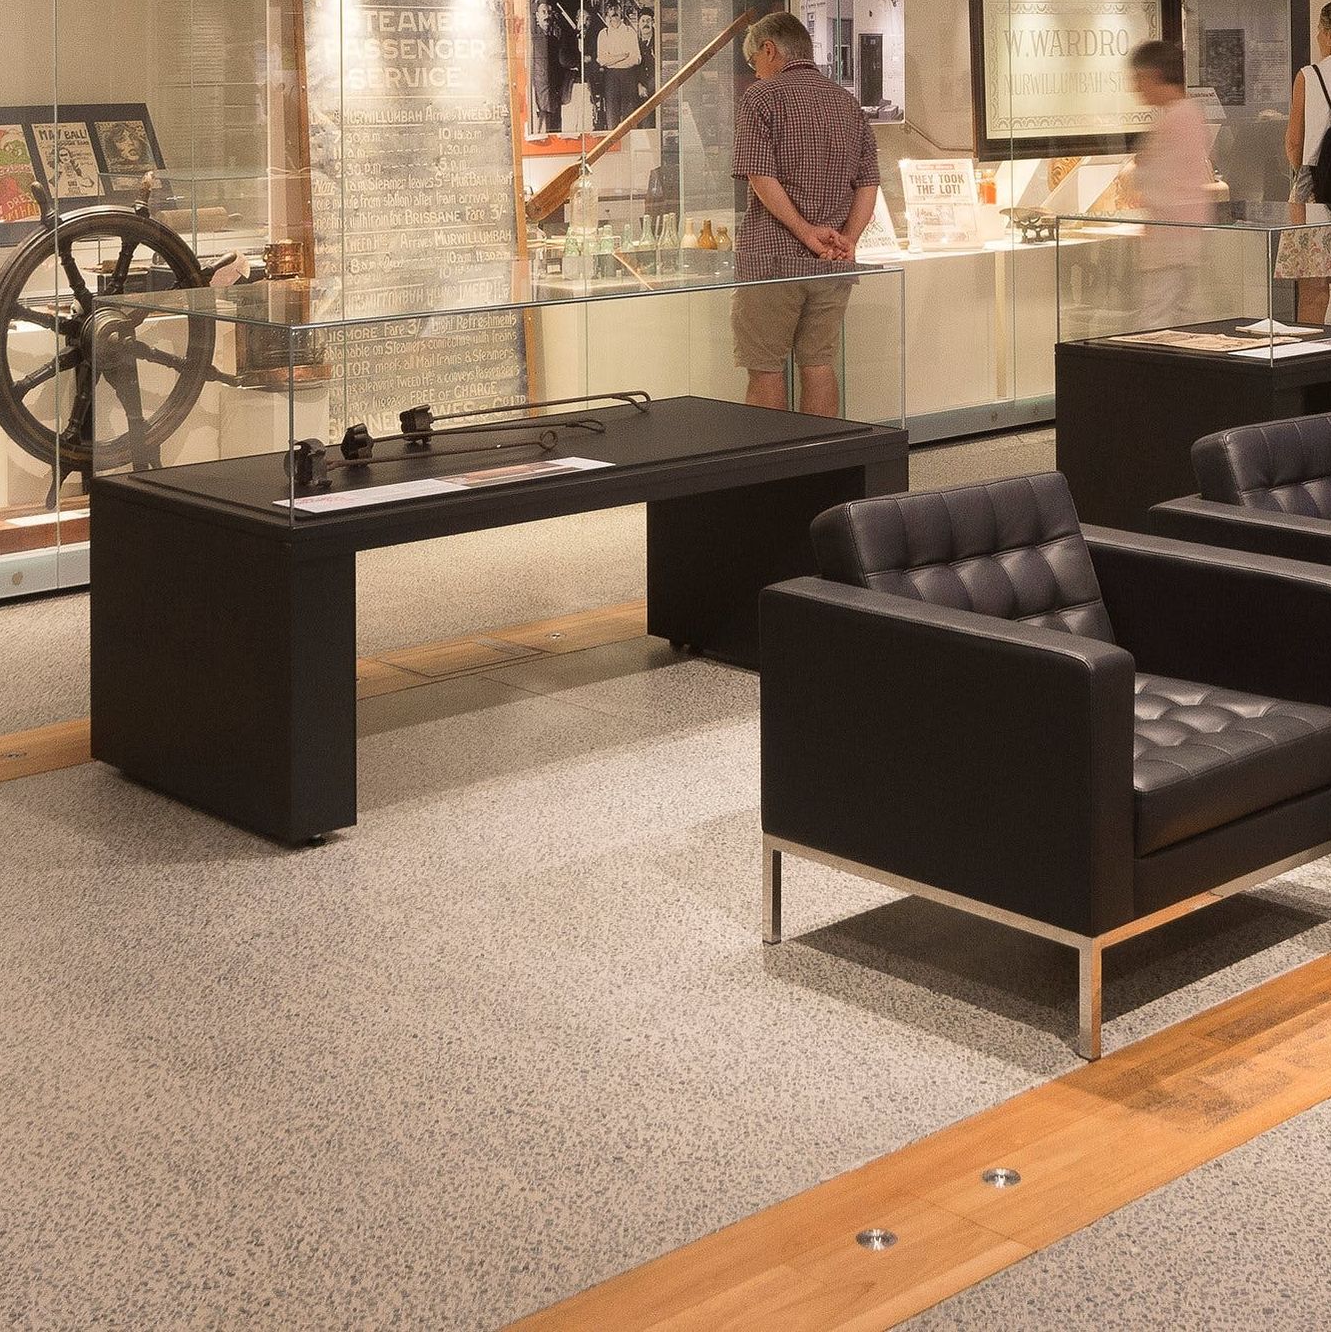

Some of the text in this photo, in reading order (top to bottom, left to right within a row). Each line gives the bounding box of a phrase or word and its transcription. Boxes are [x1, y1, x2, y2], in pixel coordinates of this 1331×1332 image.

[346, 11, 473, 34] STEAME
[326, 38, 488, 60] PASSENGER
[1004, 28, 1131, 59] W.WARDRO
[347, 68, 463, 89] SERVICE
[908, 173, 965, 184] THEY TOOK
[916, 184, 962, 195] THE LOT!
[465, 205, 485, 222] Fare
[434, 229, 512, 247] MURWILLUMBAH
[383, 322, 405, 340] Fare
[455, 311, 518, 332] Refreshments
[410, 388, 436, 405] FREE
[329, 409, 402, 437] SKINNE
